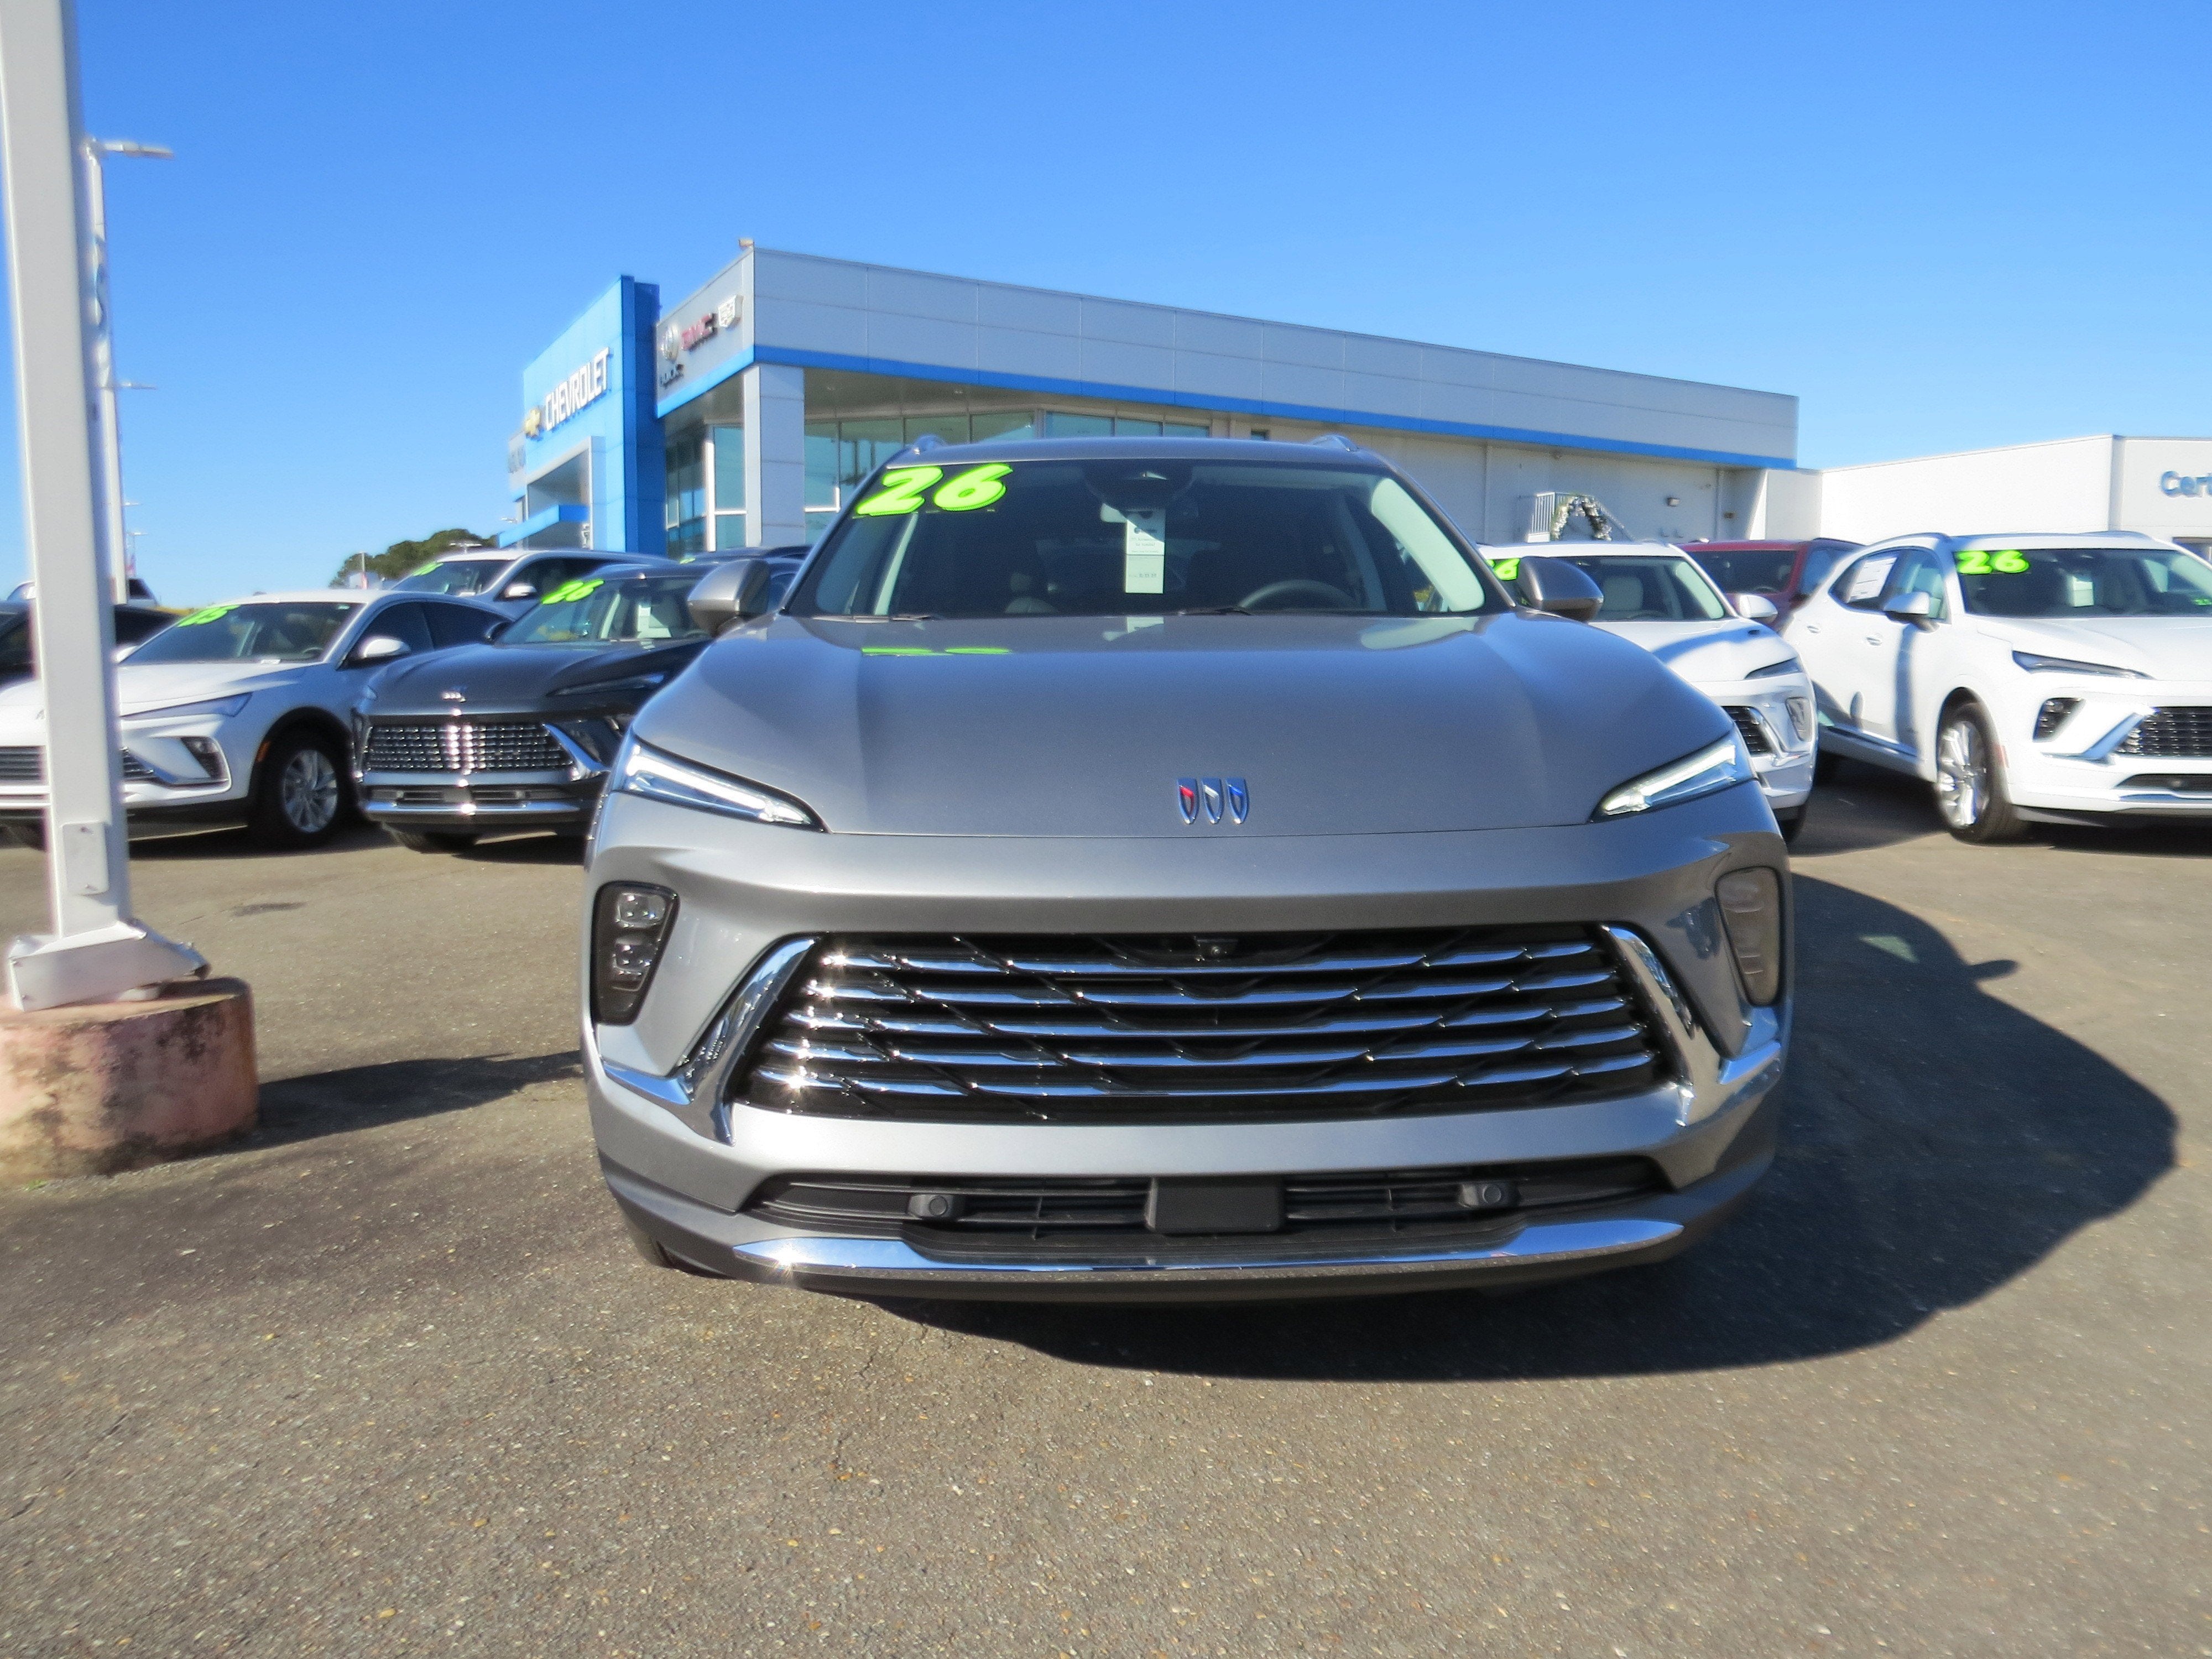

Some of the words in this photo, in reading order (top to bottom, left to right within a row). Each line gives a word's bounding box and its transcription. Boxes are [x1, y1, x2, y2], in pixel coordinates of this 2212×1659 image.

[545, 346, 609, 431] CHEVROLET
[856, 463, 1013, 517] 26
[1958, 550, 2030, 575] 26
[542, 579, 605, 604] 26
